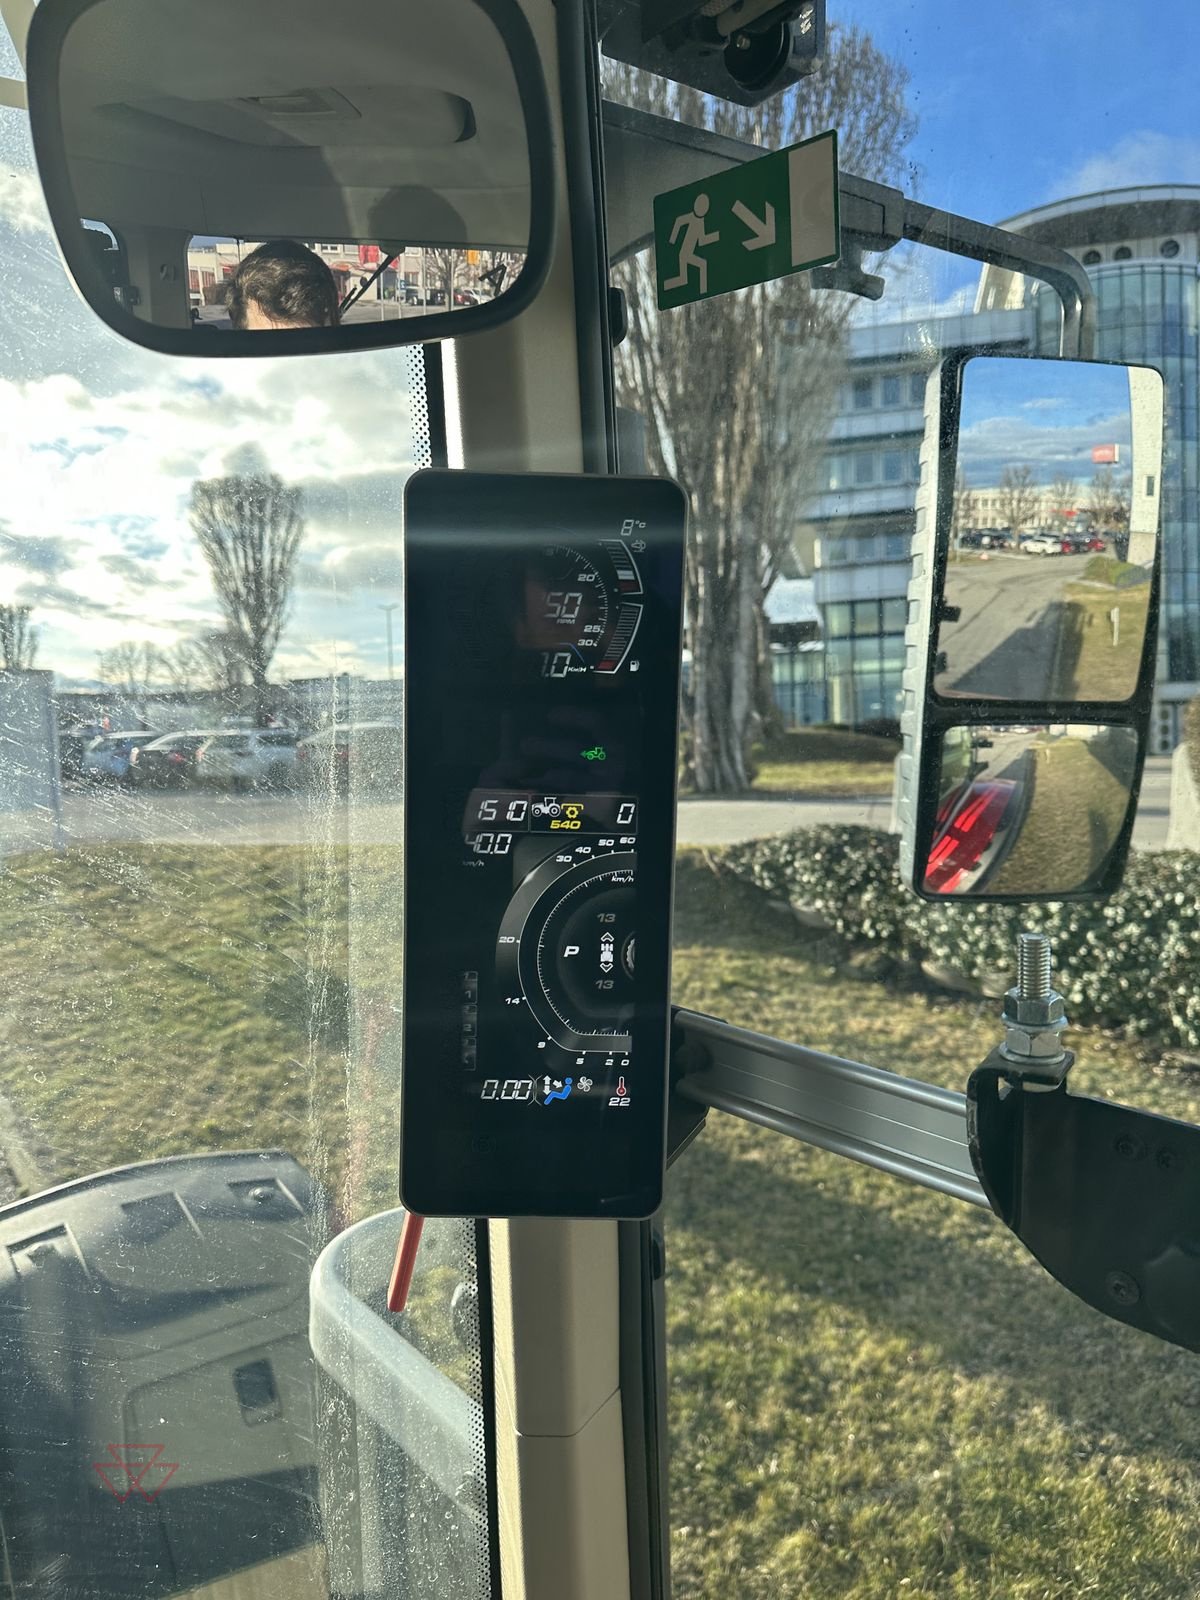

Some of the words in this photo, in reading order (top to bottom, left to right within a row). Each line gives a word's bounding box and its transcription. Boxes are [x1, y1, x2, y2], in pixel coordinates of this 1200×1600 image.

[577, 574, 596, 582] 20
[577, 639, 594, 647] 30
[616, 803, 636, 824] 0
[550, 820, 581, 829] 540
[598, 838, 615, 846] 50
[575, 846, 591, 854] 40
[611, 875, 634, 883] km/h
[597, 913, 616, 923] 13
[564, 945, 580, 957] P
[595, 980, 614, 989] 13
[504, 997, 521, 1005] 14
[604, 1058, 614, 1066] 2
[481, 1079, 533, 1101] 0.00
[608, 1097, 631, 1107] 22
